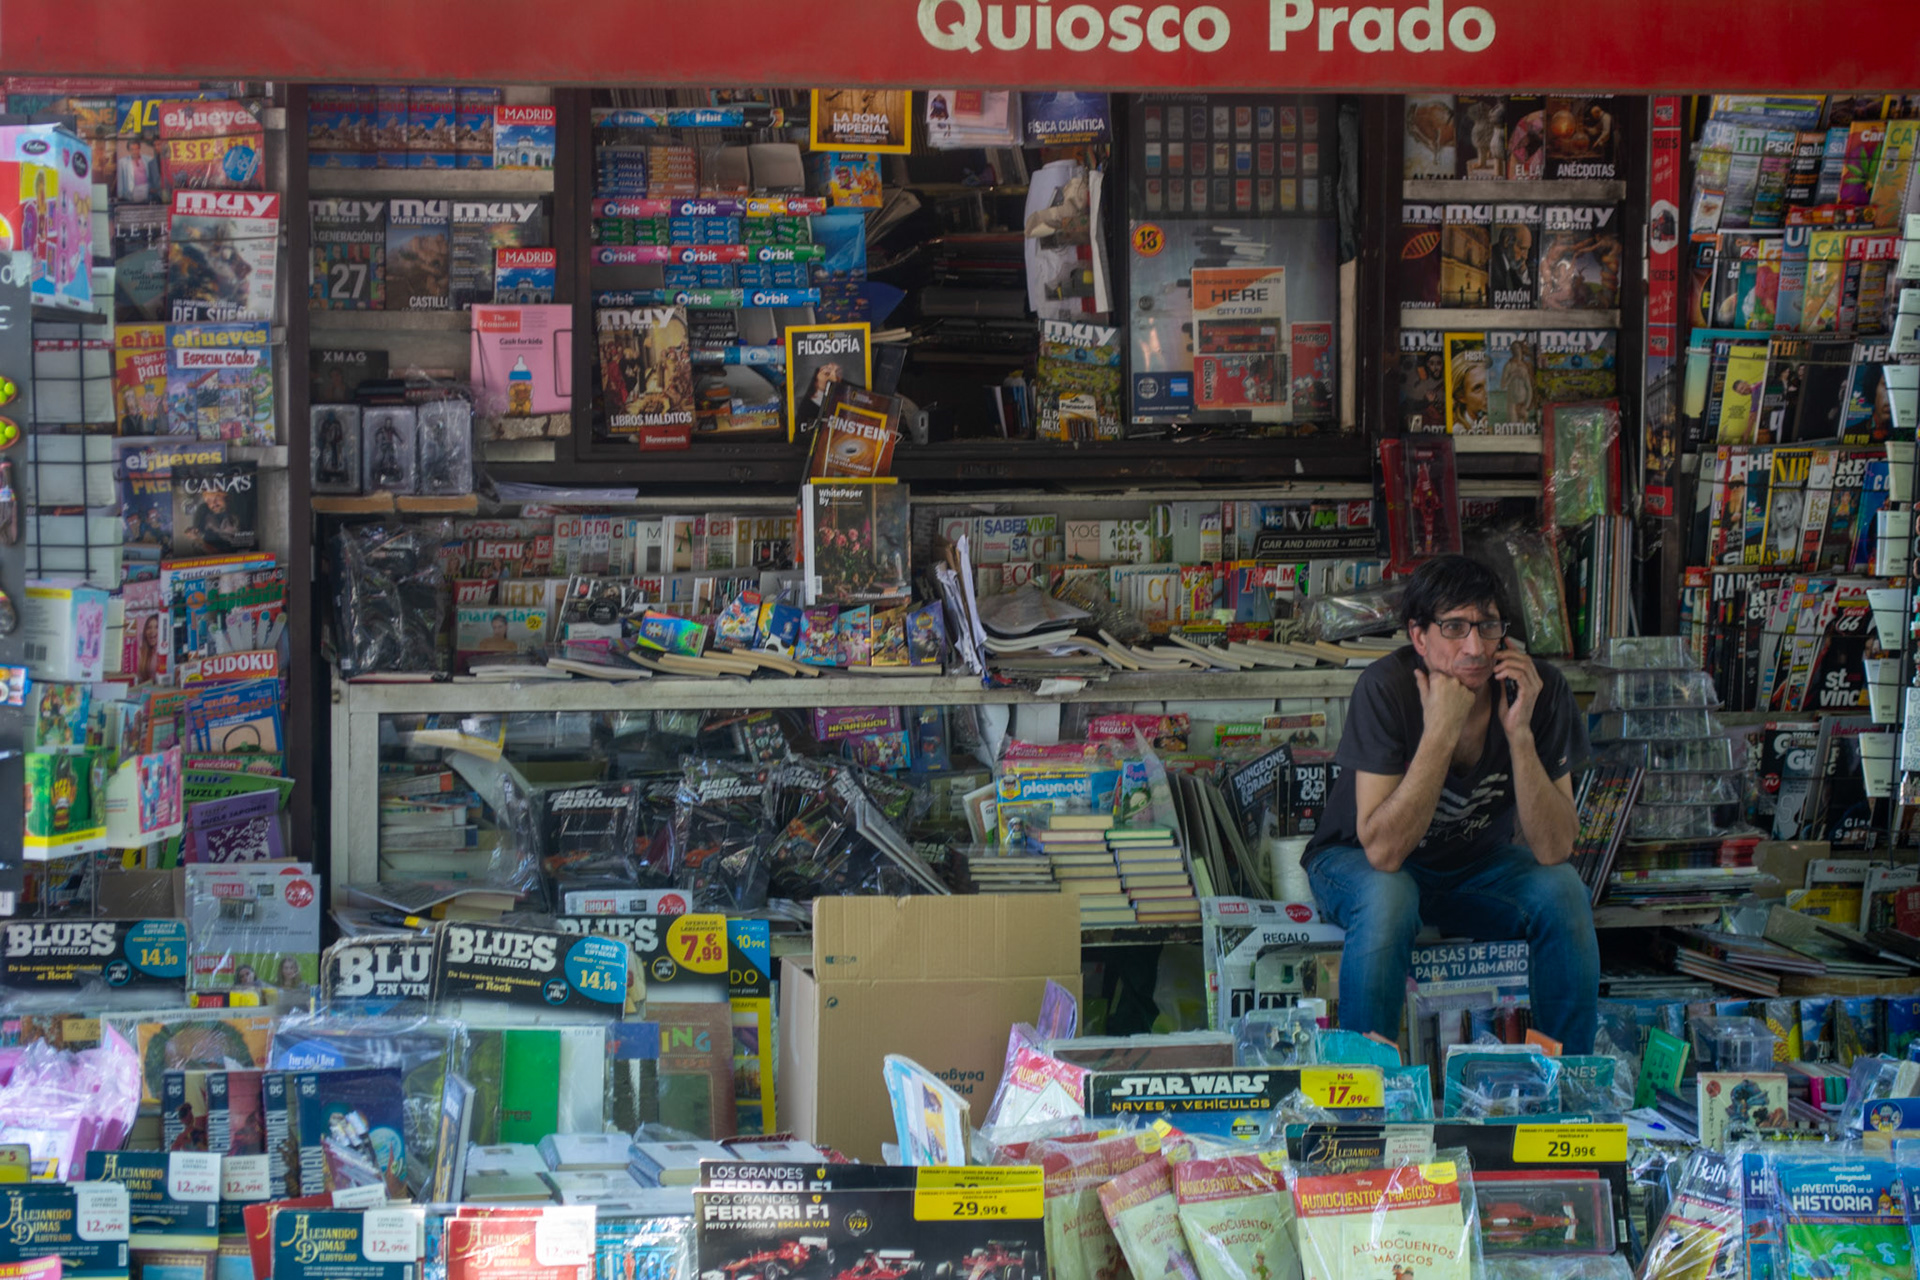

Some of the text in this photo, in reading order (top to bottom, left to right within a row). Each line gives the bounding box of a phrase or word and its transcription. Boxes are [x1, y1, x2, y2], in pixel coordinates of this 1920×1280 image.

[917, 0, 1496, 53] Quiosco Prado
[503, 108, 553, 121] MADRID
[833, 112, 889, 125] LA ROMA
[833, 123, 889, 135] IMPERIAL
[1028, 117, 1105, 134] FÍSICA CUÁNTICA
[1515, 165, 1527, 176] EL
[1557, 162, 1616, 178] ANÉCDOTAS
[176, 192, 275, 216] muy
[309, 200, 384, 222] muy
[604, 201, 641, 216] Orbit
[680, 201, 717, 216] Orbit
[453, 203, 538, 223] muy
[1545, 207, 1615, 227] muy
[505, 250, 553, 263] MADRID
[601, 248, 637, 263] Orbit
[681, 248, 718, 263] Orbit
[758, 246, 795, 261] Orbit
[331, 264, 368, 298] 27
[600, 293, 635, 307] Orbit
[676, 292, 712, 306] Orbit
[753, 292, 789, 306] Orbit
[1211, 288, 1269, 303] HERE
[1494, 288, 1531, 302] RAMÓN
[600, 308, 676, 328] muy
[1216, 307, 1263, 316] CITY TOUR
[1044, 320, 1117, 347] muy
[1540, 331, 1608, 351] muy
[797, 337, 860, 356] FILOSOFÍA
[323, 351, 367, 363] XMAG
[1061, 403, 1095, 411] Panasonic
[611, 412, 693, 427] LIBROS MALDITOS
[827, 416, 891, 442] EINSTEIN
[819, 488, 863, 498] WhitePaper
[819, 496, 828, 506] By
[984, 516, 1055, 535] SABER VIVIR
[1262, 540, 1280, 549] CAR
[1283, 539, 1303, 548] AND
[1305, 538, 1339, 548] DRIVER
[1838, 616, 1859, 632] 66
[203, 653, 274, 676] SUDOKU
[193, 760, 237, 769] reacción
[1234, 749, 1287, 790] DUNGEONS
[699, 777, 735, 793] FAST
[702, 784, 763, 801] FURIOUS
[1023, 780, 1092, 798] playmobil
[184, 788, 222, 798] PUZLE
[550, 789, 594, 802] FAST
[552, 796, 628, 812] FURIOUS
[212, 883, 244, 896] ¡HOLA!
[584, 900, 616, 912] ¡HOLA!
[1219, 903, 1249, 913] ¡HOLA!
[5, 922, 116, 957] BLUES
[1263, 932, 1310, 943] REGALO
[33, 946, 89, 956] EN VINILO
[446, 927, 557, 973] BLUES
[1412, 947, 1492, 967] BOLSAS DE
[474, 955, 529, 969] EN VINILO
[47, 971, 73, 981] Rock
[1416, 961, 1536, 983] PARA TU ARMARIO
[376, 984, 396, 996] EN
[485, 981, 512, 993] Rock
[1111, 1074, 1270, 1096] STAR WARS
[1328, 1085, 1370, 1106] 17,99€
[1111, 1101, 1165, 1112] NAVES
[1182, 1098, 1270, 1110] VEHÍCULOS
[1314, 1139, 1380, 1164] ALEJANDRO
[1548, 1141, 1596, 1158] 29,99€
[96, 1154, 164, 1183] ALEJANDRO
[709, 1167, 804, 1180] LOS GRANDES
[1355, 1178, 1373, 1187] Disney
[1835, 1174, 1872, 1182] playmobil
[176, 1180, 213, 1193] 12,99€
[226, 1181, 263, 1193] 12,99€
[1801, 1183, 1857, 1194] AVENTURA
[703, 1194, 799, 1205] LOS GRANDES
[1301, 1190, 1383, 1210] AUDIOCUENTOS
[1792, 1195, 1873, 1211] HISTORIA
[0, 1196, 72, 1229] ALEJANDRO
[703, 1203, 830, 1221] FERRARI F1
[10, 1217, 60, 1246] DUMAS
[86, 1219, 124, 1233] 12,99€
[280, 1215, 358, 1247] ALEJANDRO
[705, 1222, 726, 1230] MITO
[777, 1221, 811, 1229] ESCALA
[812, 1220, 830, 1228] 1/24
[848, 1221, 868, 1230] 1/24
[294, 1238, 346, 1264] DUMAS
[371, 1241, 410, 1254] 12,99€
[1352, 1238, 1456, 1260] AUDIOCUENTOS
[1373, 1252, 1433, 1267] MÁGICOS
